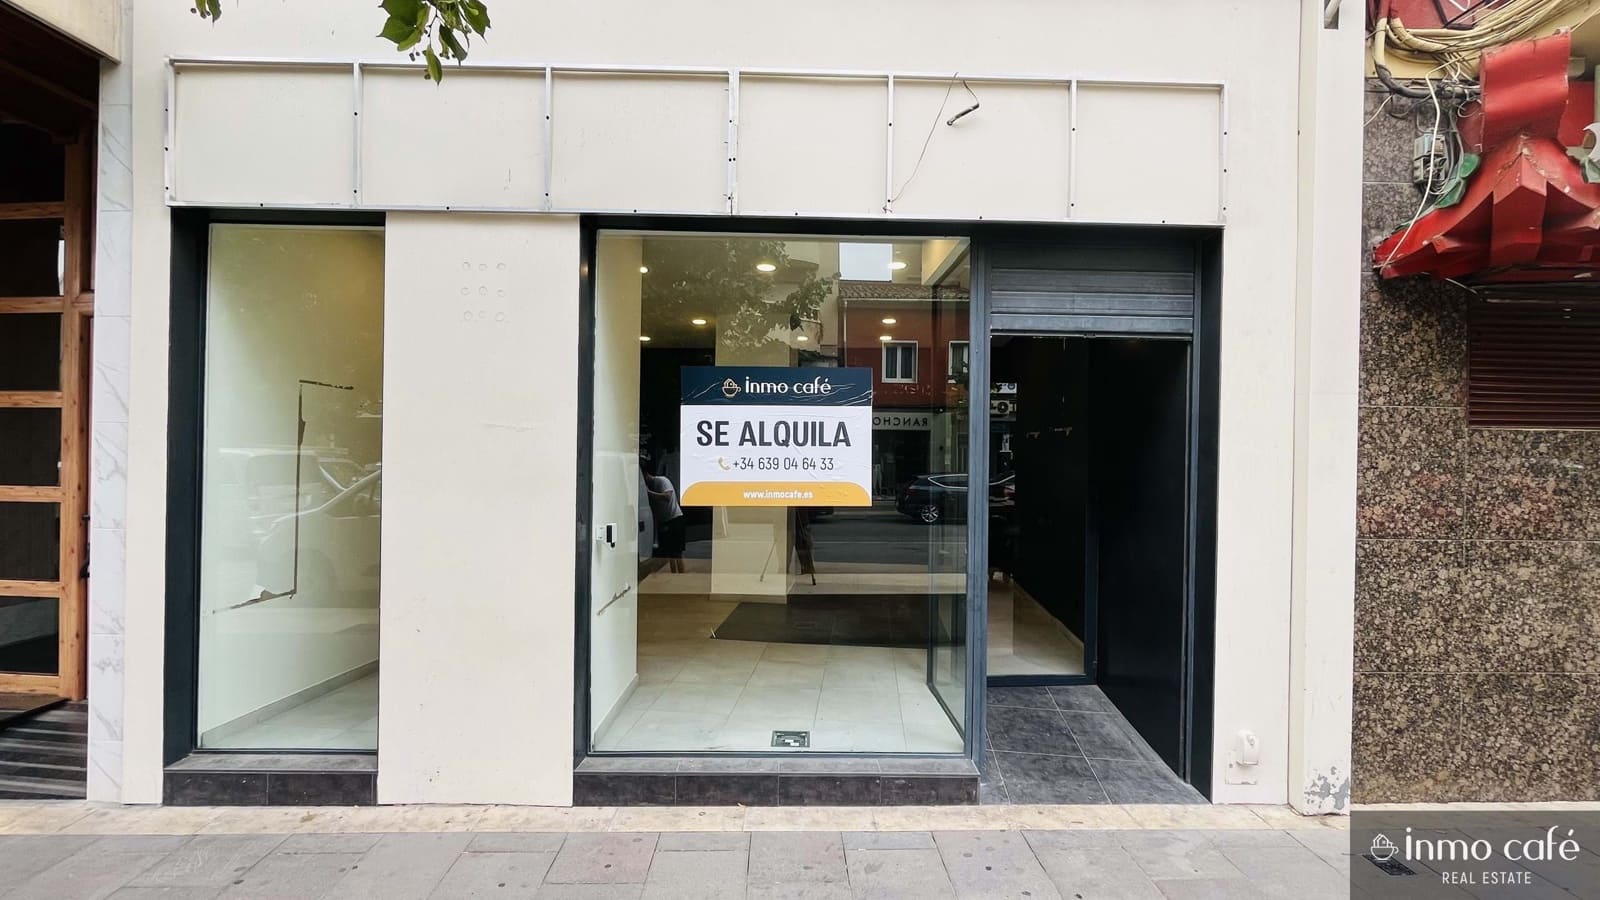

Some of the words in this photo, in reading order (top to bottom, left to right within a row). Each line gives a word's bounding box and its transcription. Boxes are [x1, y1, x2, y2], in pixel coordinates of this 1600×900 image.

[745, 376, 789, 394] inmo
[793, 376, 832, 394] café
[696, 420, 730, 447] SE
[738, 420, 852, 448] ALQUILA
[733, 457, 754, 470] +34
[758, 457, 780, 470] 639
[783, 457, 798, 470] 04
[802, 457, 816, 470] 64
[820, 457, 834, 470] 33
[743, 490, 814, 500] www.inmocafe.es
